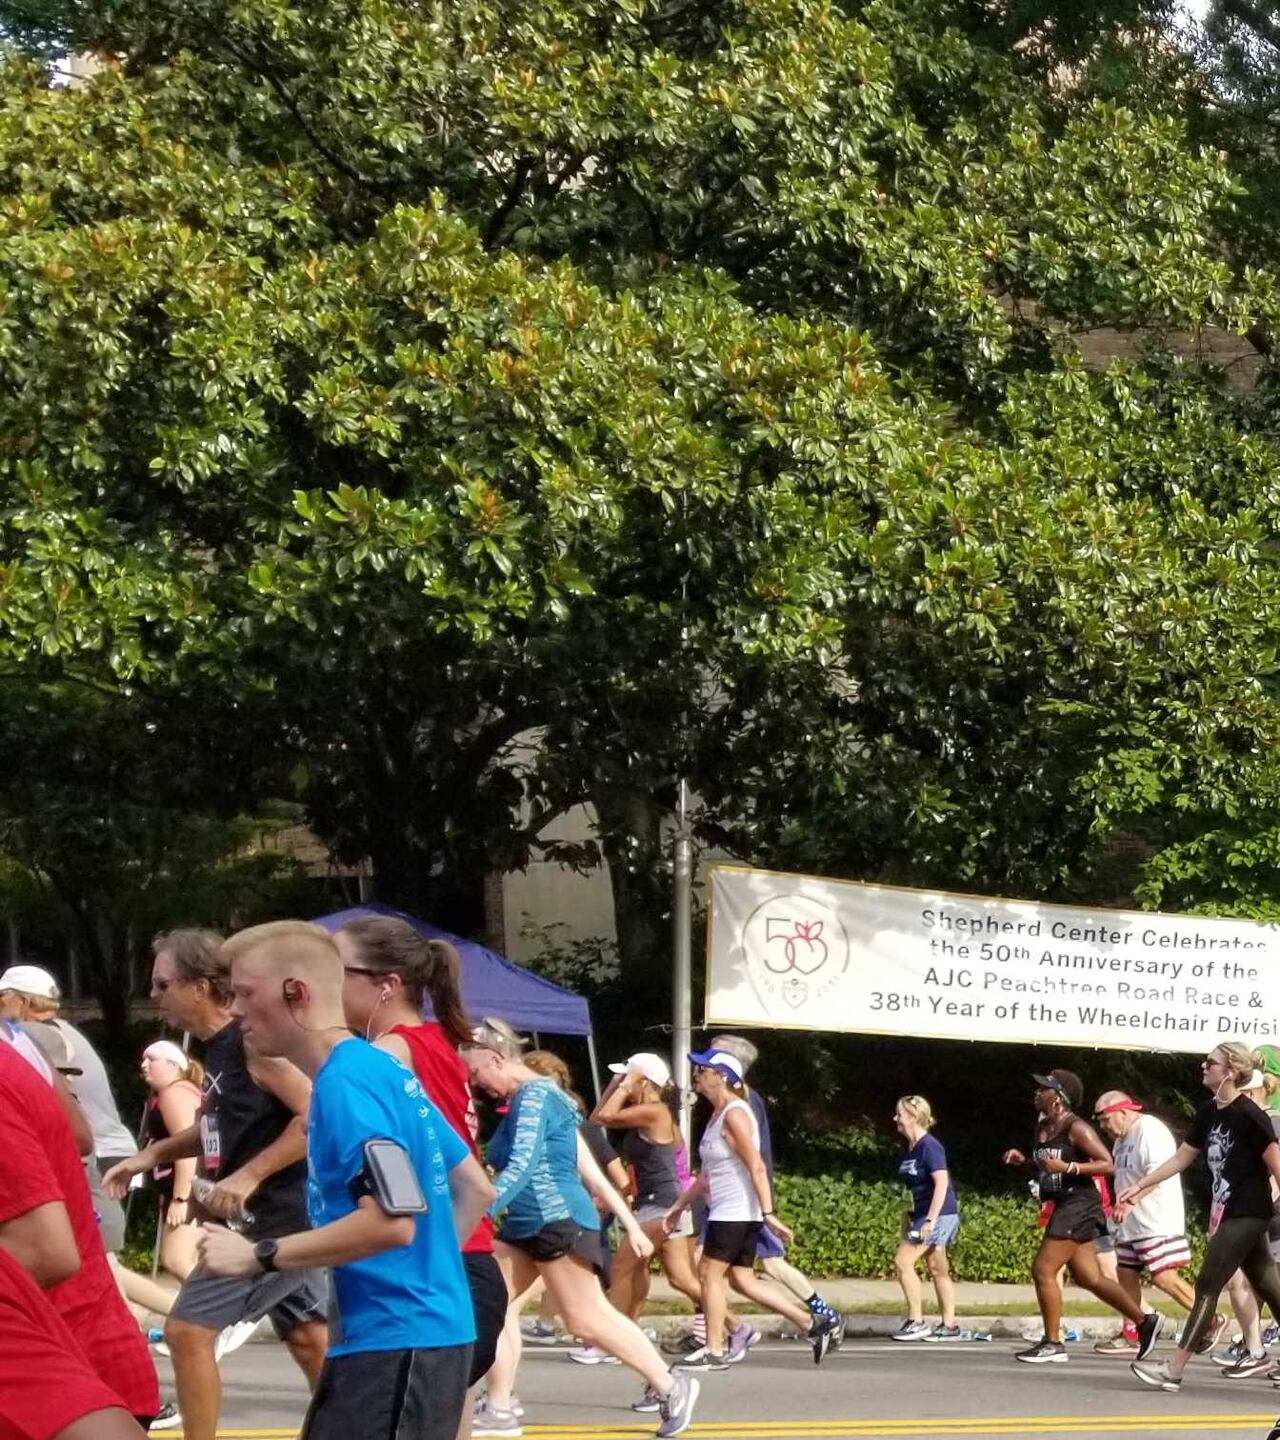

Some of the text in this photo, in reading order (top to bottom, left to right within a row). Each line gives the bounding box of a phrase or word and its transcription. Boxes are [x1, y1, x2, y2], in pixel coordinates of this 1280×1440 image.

[921, 909, 1041, 938] Shepherd
[1051, 921, 1134, 946] Center
[929, 938, 1259, 981] the 50th Anniversary of the
[922, 967, 1264, 1010] AJC Peachtree Road Race &
[869, 991, 921, 1012] 38th
[928, 995, 986, 1018] Year
[994, 1002, 1020, 1020] of
[1028, 1003, 1068, 1024] the
[1077, 1006, 1210, 1035] Wheelchair
